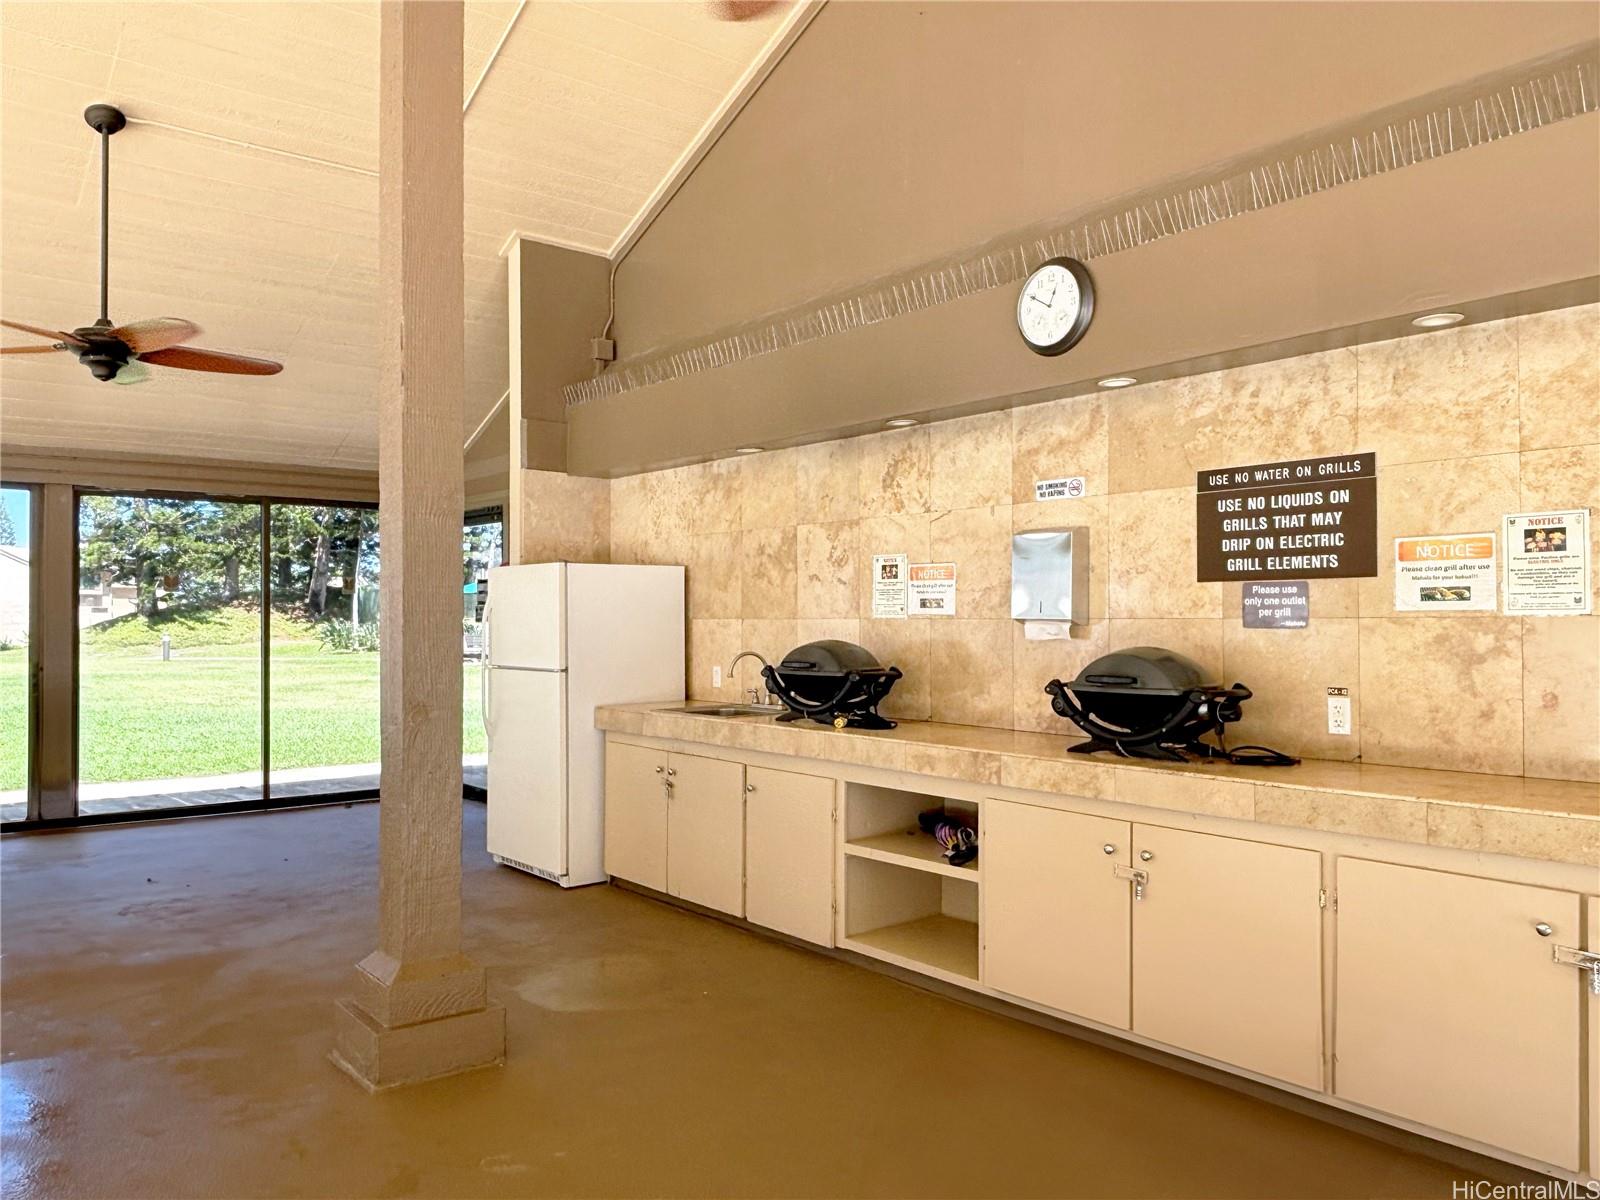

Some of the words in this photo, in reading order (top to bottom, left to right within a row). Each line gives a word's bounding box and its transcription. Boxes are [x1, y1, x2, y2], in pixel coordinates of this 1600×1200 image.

[1209, 474, 1229, 486] USE
[1235, 472, 1249, 483] NO
[1255, 468, 1290, 481] WATER
[1296, 465, 1312, 477] ON
[1318, 460, 1361, 476] GRILLS
[1218, 498, 1242, 512] USE
[1248, 496, 1266, 510] NO
[1271, 492, 1324, 509] LIQUIDS
[1330, 489, 1350, 503] ON
[1223, 516, 1268, 532] GRILLS
[1273, 514, 1306, 529] THAT
[1311, 512, 1342, 526] MAY
[1527, 516, 1564, 526] NOTICE
[1222, 538, 1250, 552] DRIP
[1256, 537, 1274, 550] ON
[1280, 532, 1345, 550] ELECTRIC
[1416, 543, 1474, 559] NOTICE
[1227, 558, 1262, 572] GRILL
[1267, 554, 1338, 570] ELEMENTS
[1444, 564, 1458, 572] grill
[918, 570, 944, 579] NOTICE
[1252, 585, 1280, 594] Please
[1282, 586, 1298, 594] use
[1244, 596, 1262, 607] only
[1282, 596, 1306, 605] outlet
[1258, 609, 1272, 618] per
[1274, 607, 1292, 618] grill
